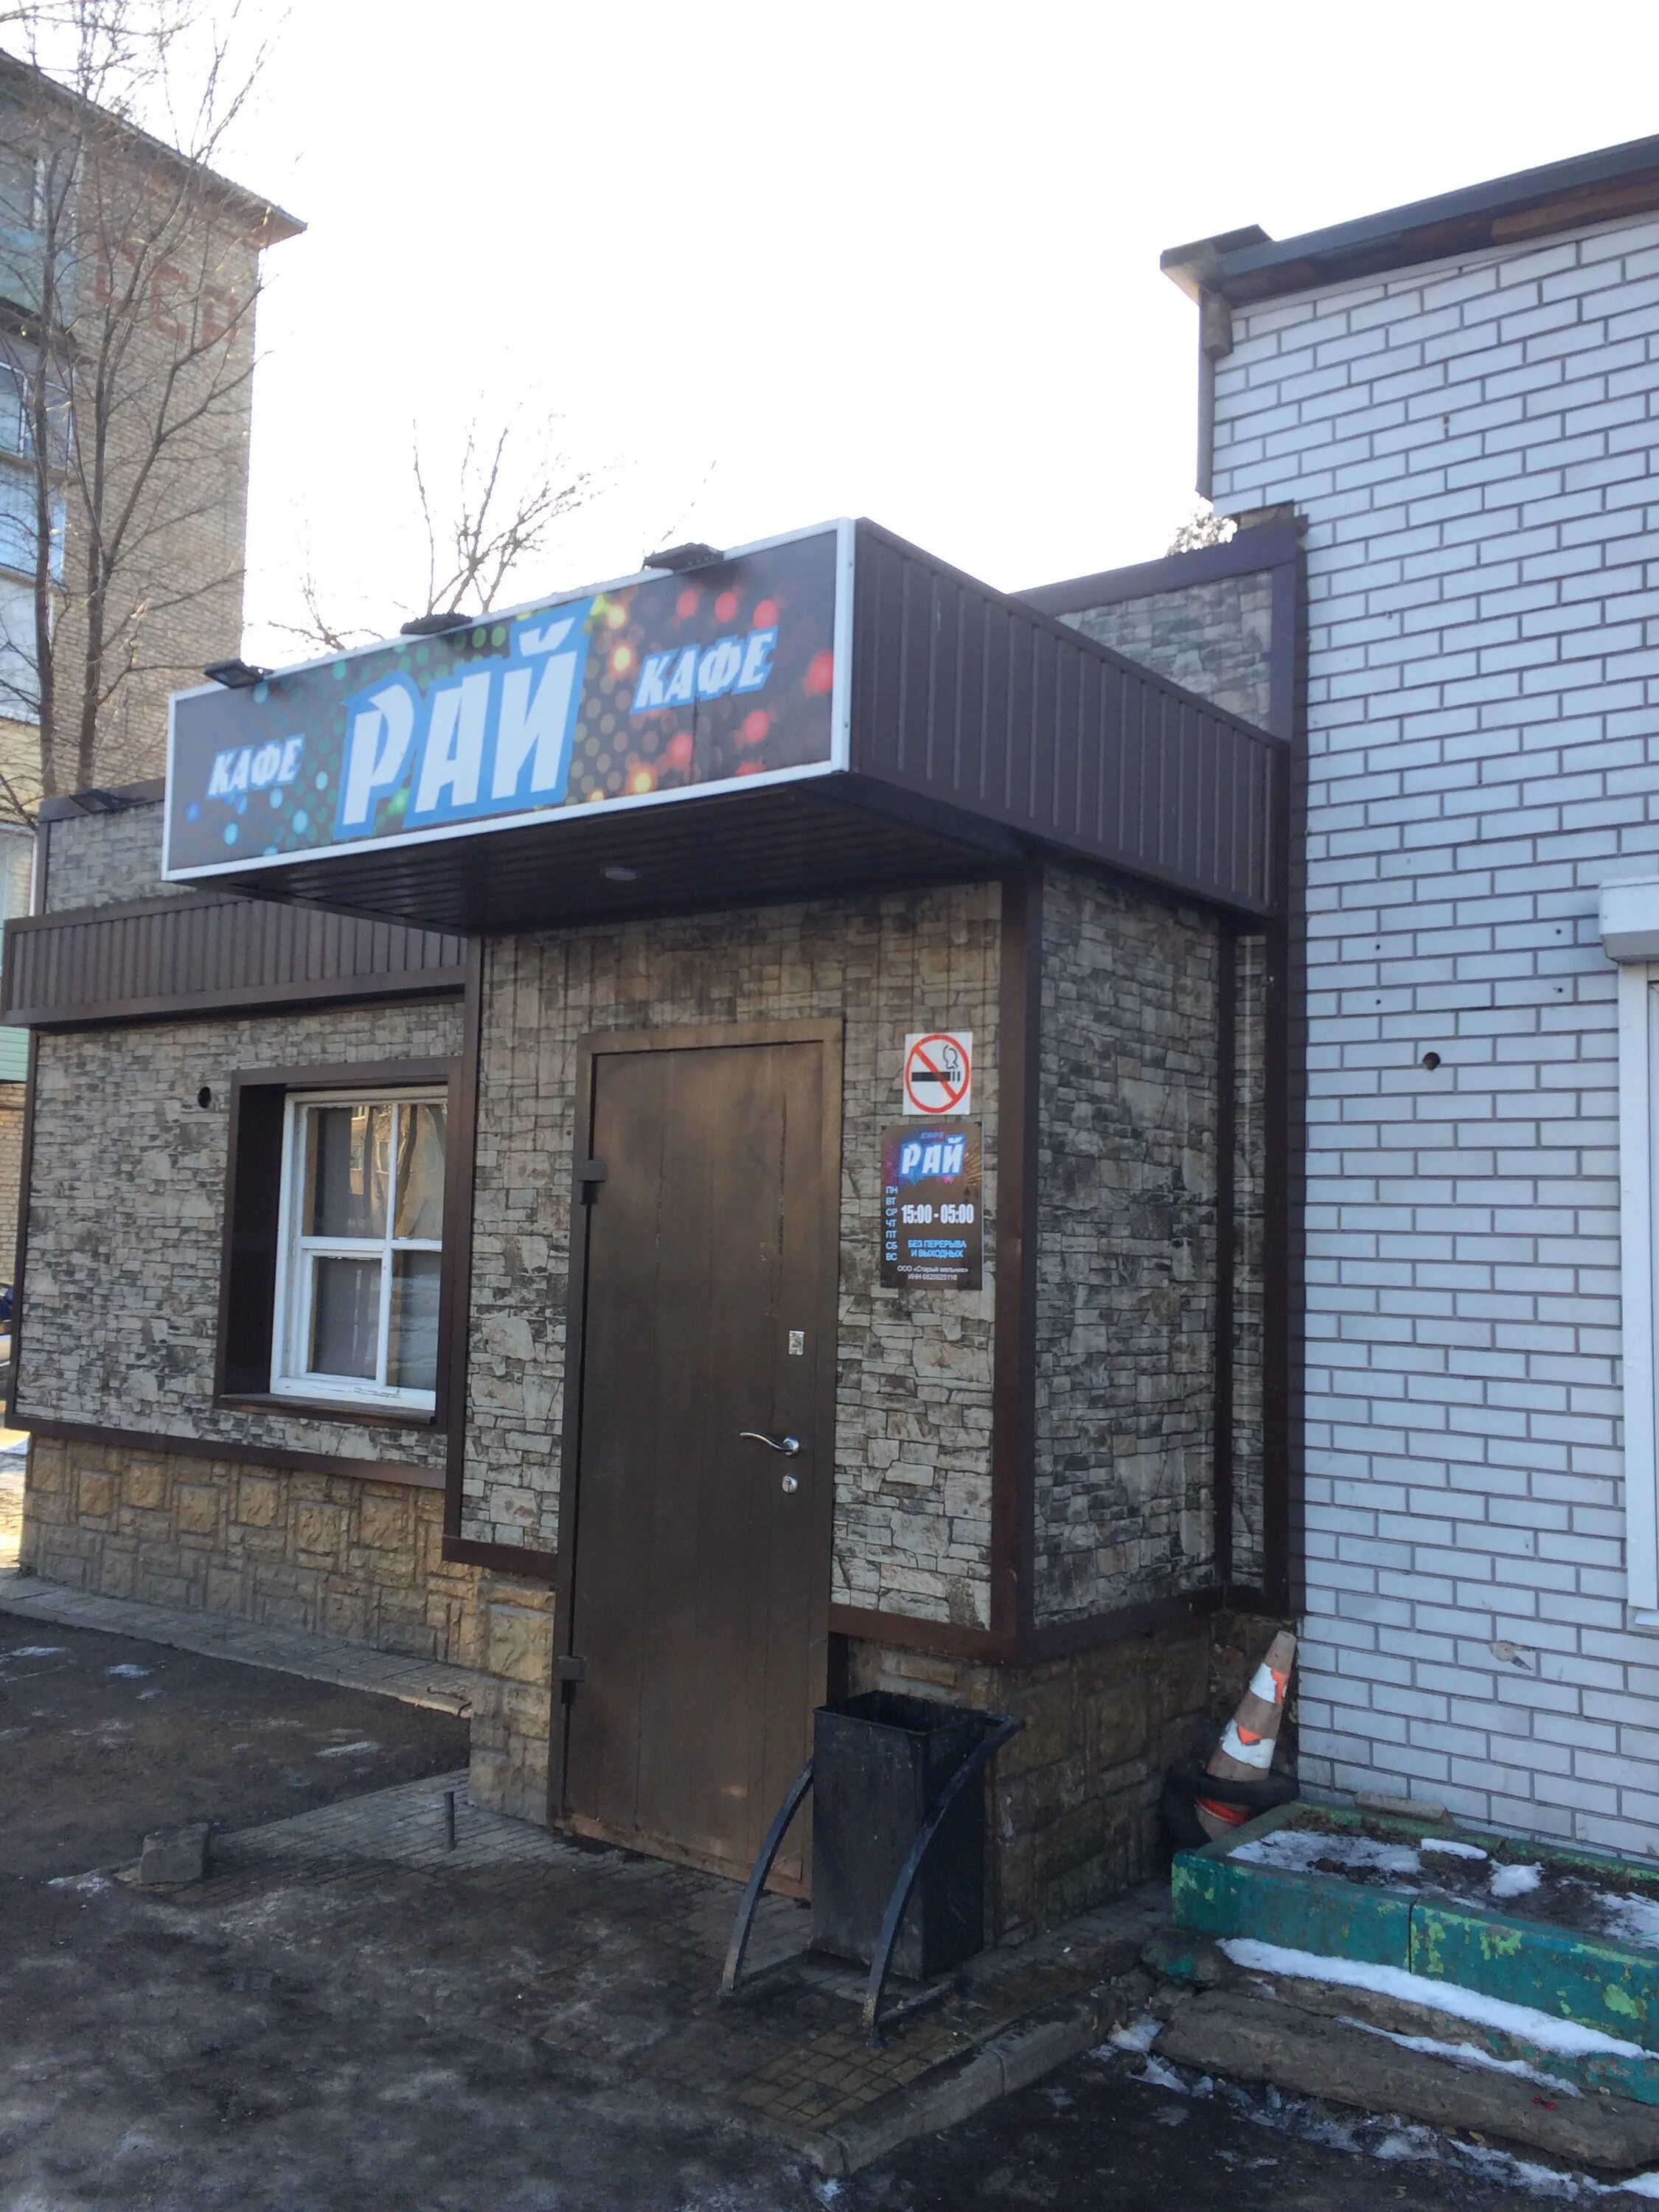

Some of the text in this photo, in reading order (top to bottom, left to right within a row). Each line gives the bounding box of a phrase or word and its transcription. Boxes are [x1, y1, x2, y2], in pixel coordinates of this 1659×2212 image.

[207, 617, 773, 826] КАФЕ РАЙ КАФЕ
[900, 1136, 964, 1175] РАЙ
[886, 1186, 898, 1194] ПН
[886, 1197, 897, 1206] ВТ
[886, 1208, 898, 1216] СР
[901, 1204, 932, 1224] 15:00
[940, 1204, 974, 1224] 05:00
[886, 1219, 897, 1227] ЧТ
[886, 1230, 897, 1238] ПТ
[886, 1241, 898, 1250] СБ
[908, 1239, 967, 1248] БЕЗ ПЕРЕРЫВА
[886, 1252, 897, 1261] ВС
[911, 1249, 964, 1258] И ВЫХОДНЫХ
